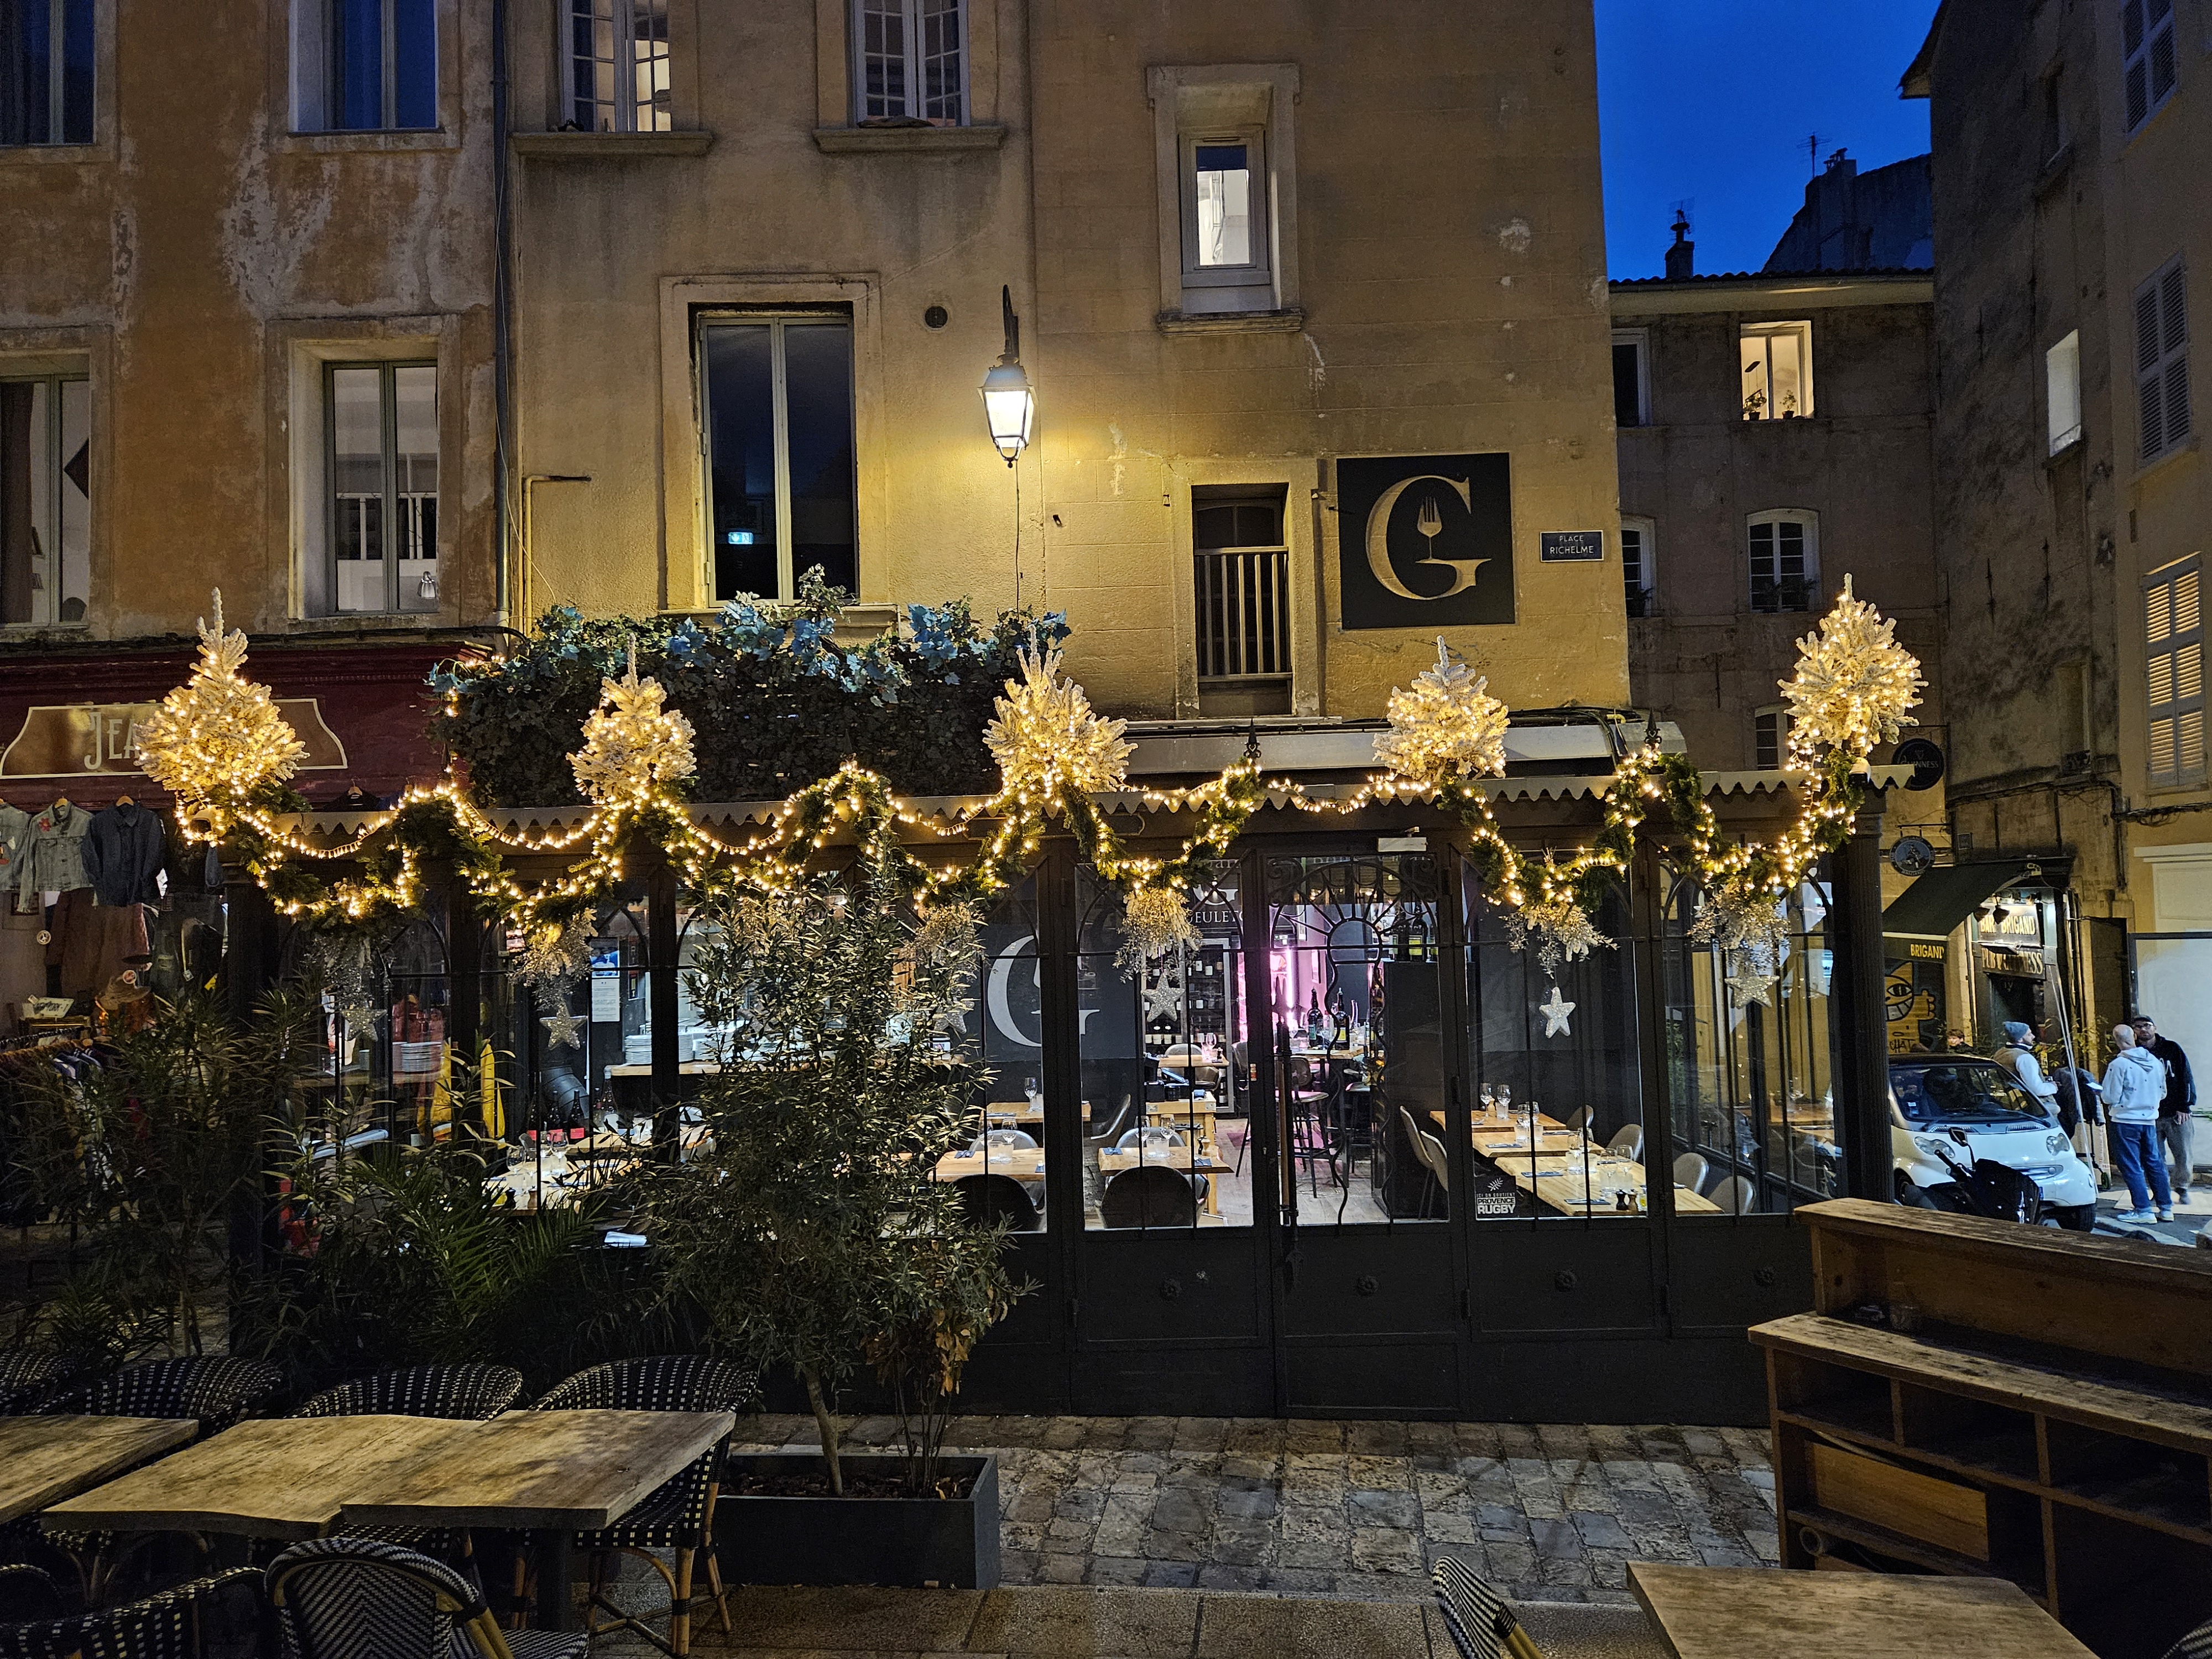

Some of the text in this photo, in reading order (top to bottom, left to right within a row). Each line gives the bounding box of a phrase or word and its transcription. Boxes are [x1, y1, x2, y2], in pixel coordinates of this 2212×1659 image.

[1366, 475, 1492, 600] G
[1550, 545, 1594, 554] RICHELME
[1980, 914, 2036, 935] BAR BRIGAND
[1910, 943, 1944, 959] BRIGAND
[1981, 947, 2043, 974] PUB GNESS
[1477, 1204, 1516, 1214] RUGBY
